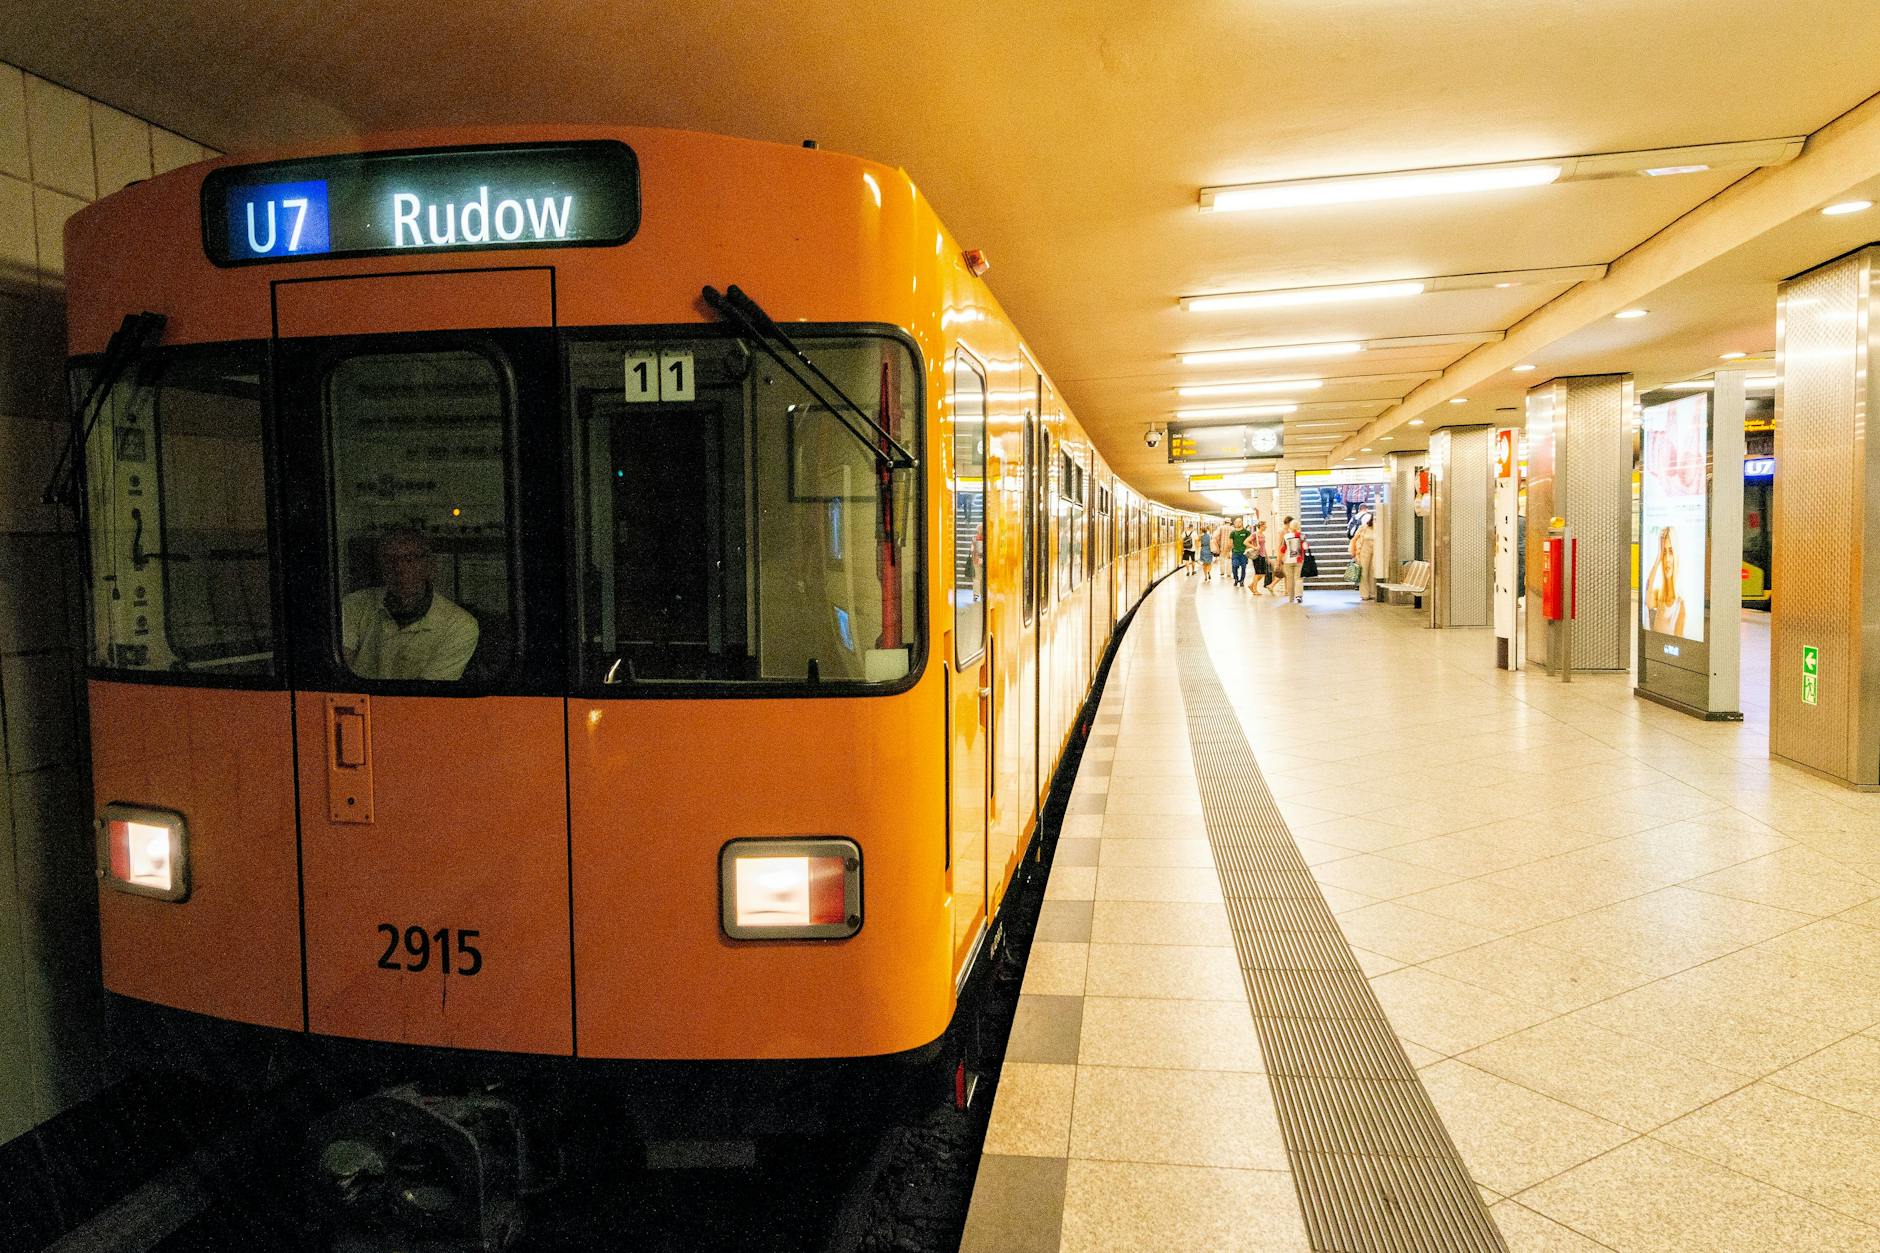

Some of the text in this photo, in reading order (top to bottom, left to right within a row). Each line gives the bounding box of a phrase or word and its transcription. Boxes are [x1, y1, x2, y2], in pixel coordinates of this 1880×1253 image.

[247, 186, 572, 253] U7 Rudow
[1746, 460, 1772, 475] U7
[377, 923, 482, 976] 2915
